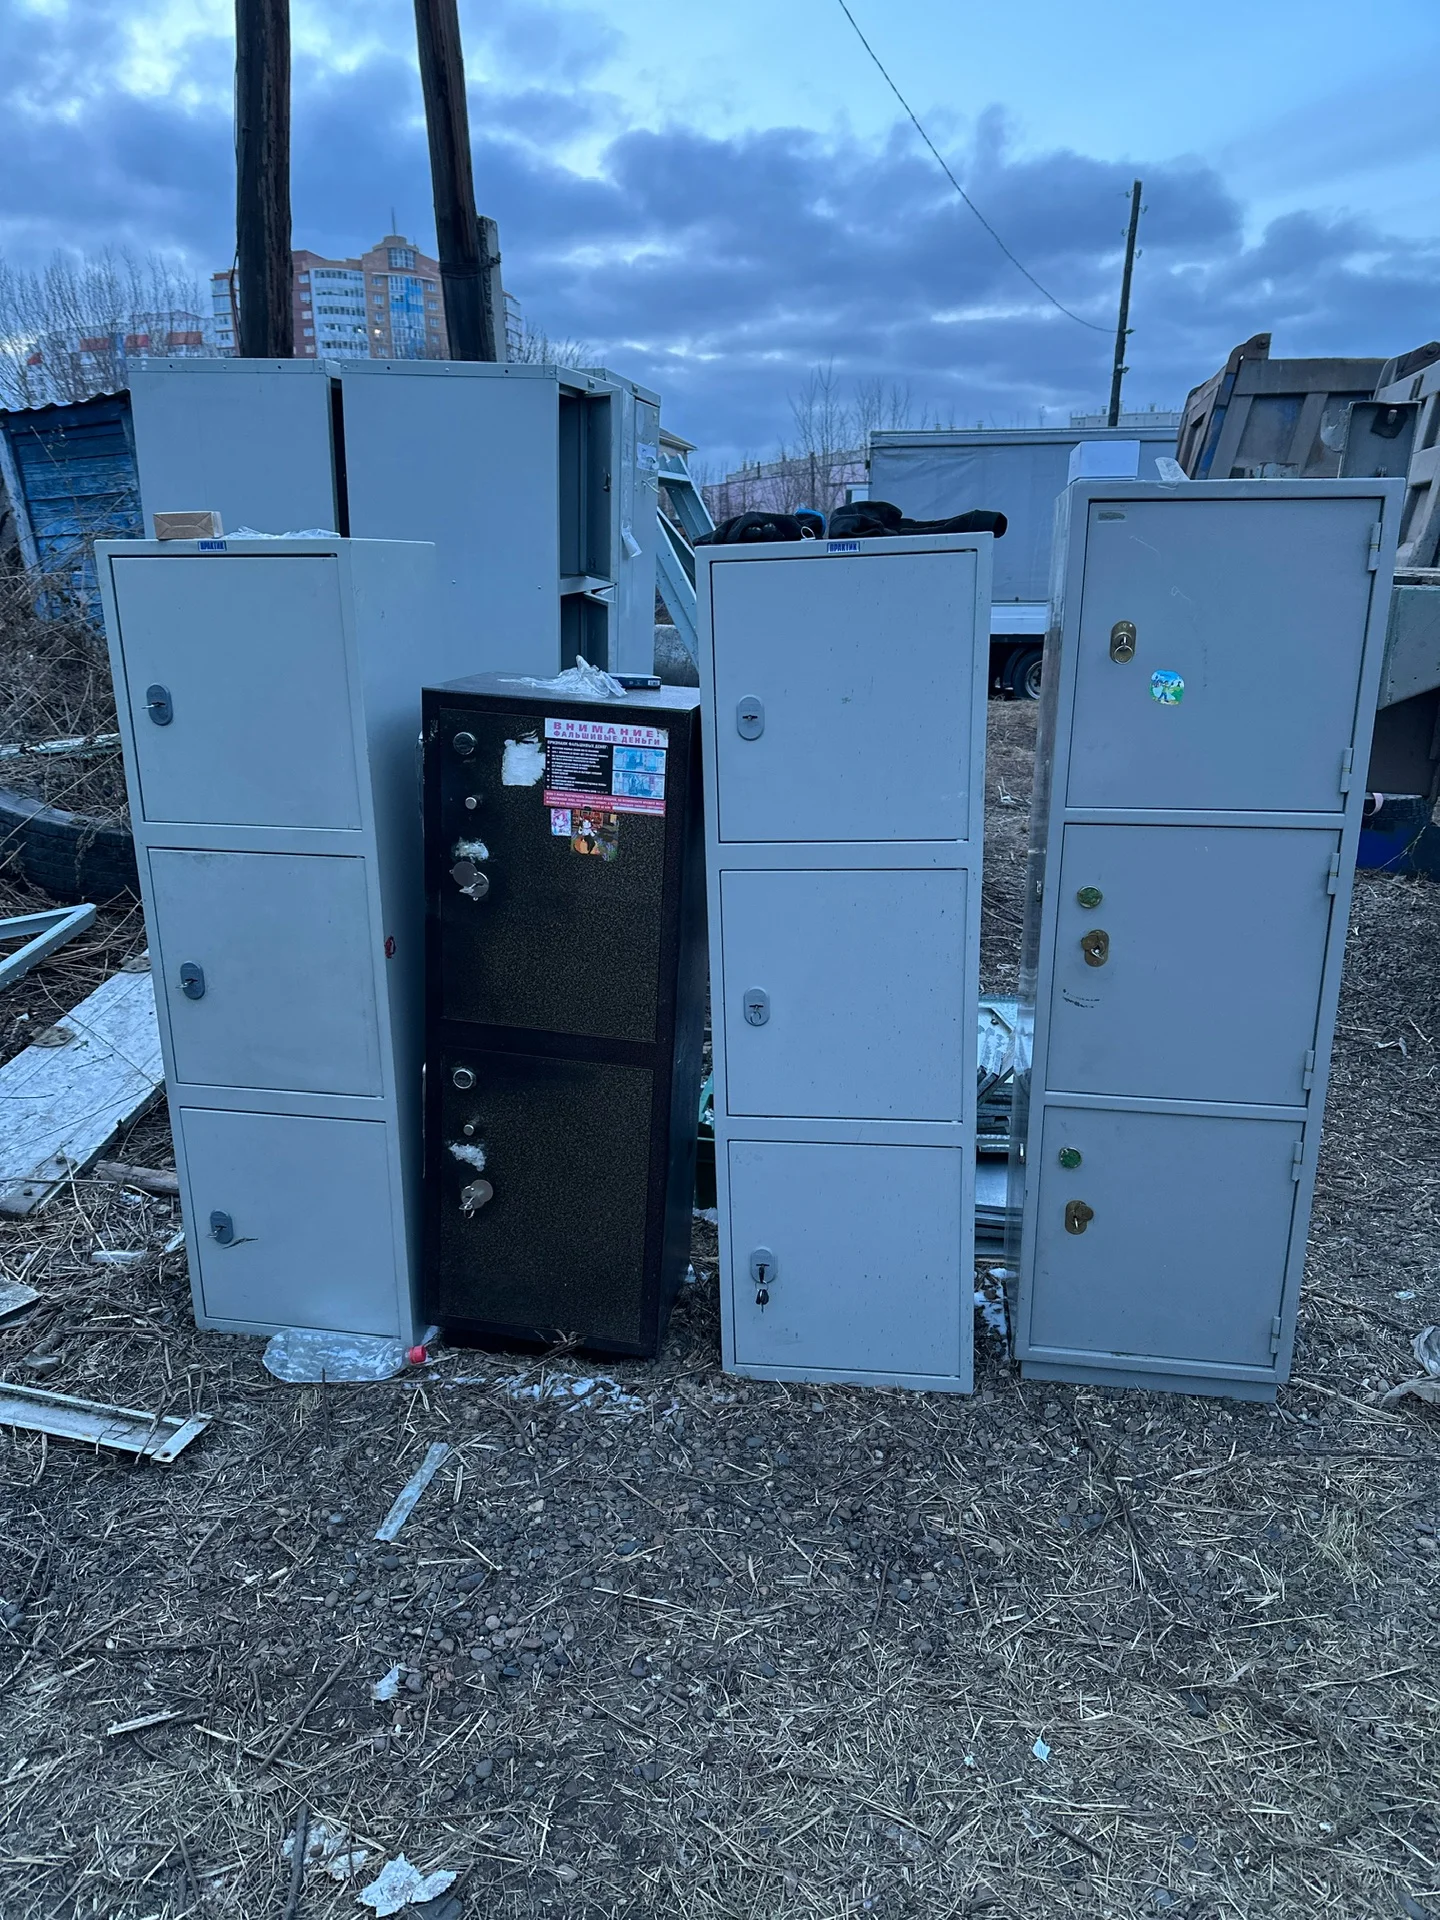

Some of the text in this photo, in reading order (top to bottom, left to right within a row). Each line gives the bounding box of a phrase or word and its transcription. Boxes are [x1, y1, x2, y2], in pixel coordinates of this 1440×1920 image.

[829, 542, 858, 552] ПРАКТИК
[553, 730, 661, 746] ФАЛЬШИВЫЕ ДЕНЬГИ
